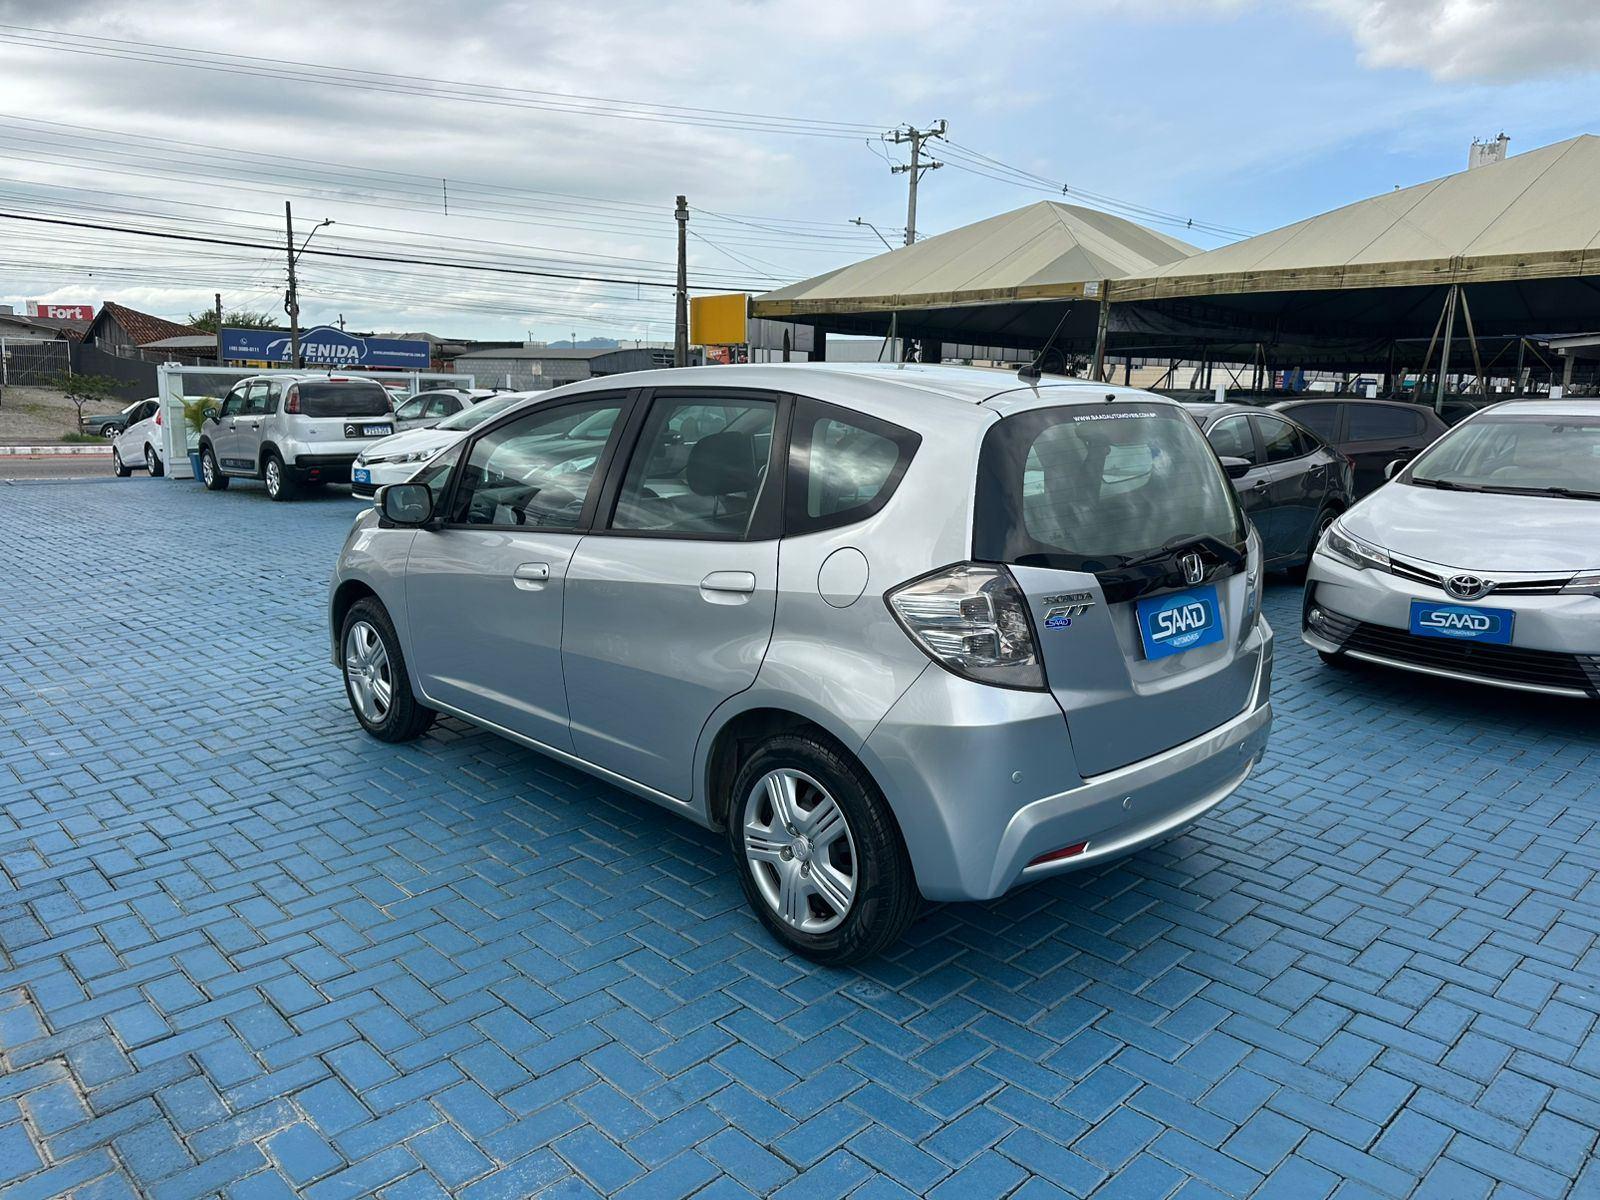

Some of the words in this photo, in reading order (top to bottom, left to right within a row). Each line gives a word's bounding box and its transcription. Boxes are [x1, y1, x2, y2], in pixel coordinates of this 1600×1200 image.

[47, 306, 83, 320] Fort
[282, 342, 359, 358] AVENIDA
[281, 355, 359, 364] MTIMARCAS
[1044, 602, 1096, 619] FIT
[1046, 618, 1069, 627] SAAD
[1152, 602, 1205, 640] SAAD
[1420, 612, 1489, 630] SAAD
